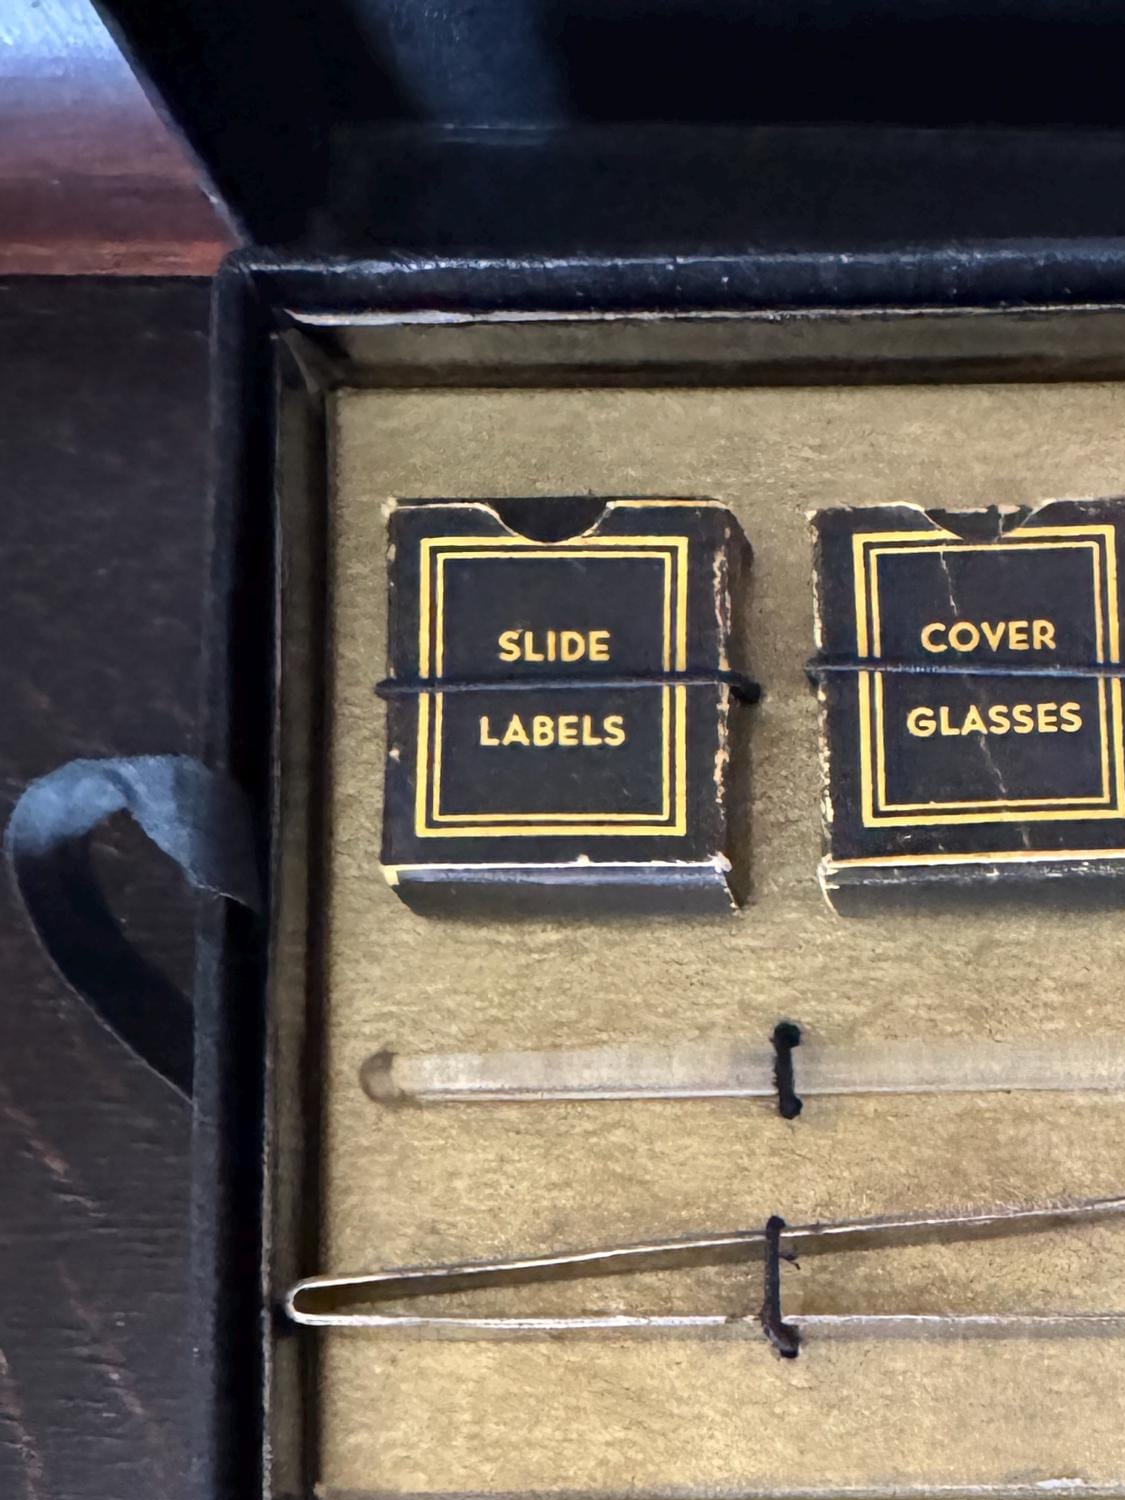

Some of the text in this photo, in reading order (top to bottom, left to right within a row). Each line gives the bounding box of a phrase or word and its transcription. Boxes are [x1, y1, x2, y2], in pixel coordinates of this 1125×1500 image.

[498, 630, 611, 662] SLIDE
[920, 619, 1057, 653] COVER
[479, 714, 626, 747] LABELS
[906, 702, 1083, 737] GLASSES
